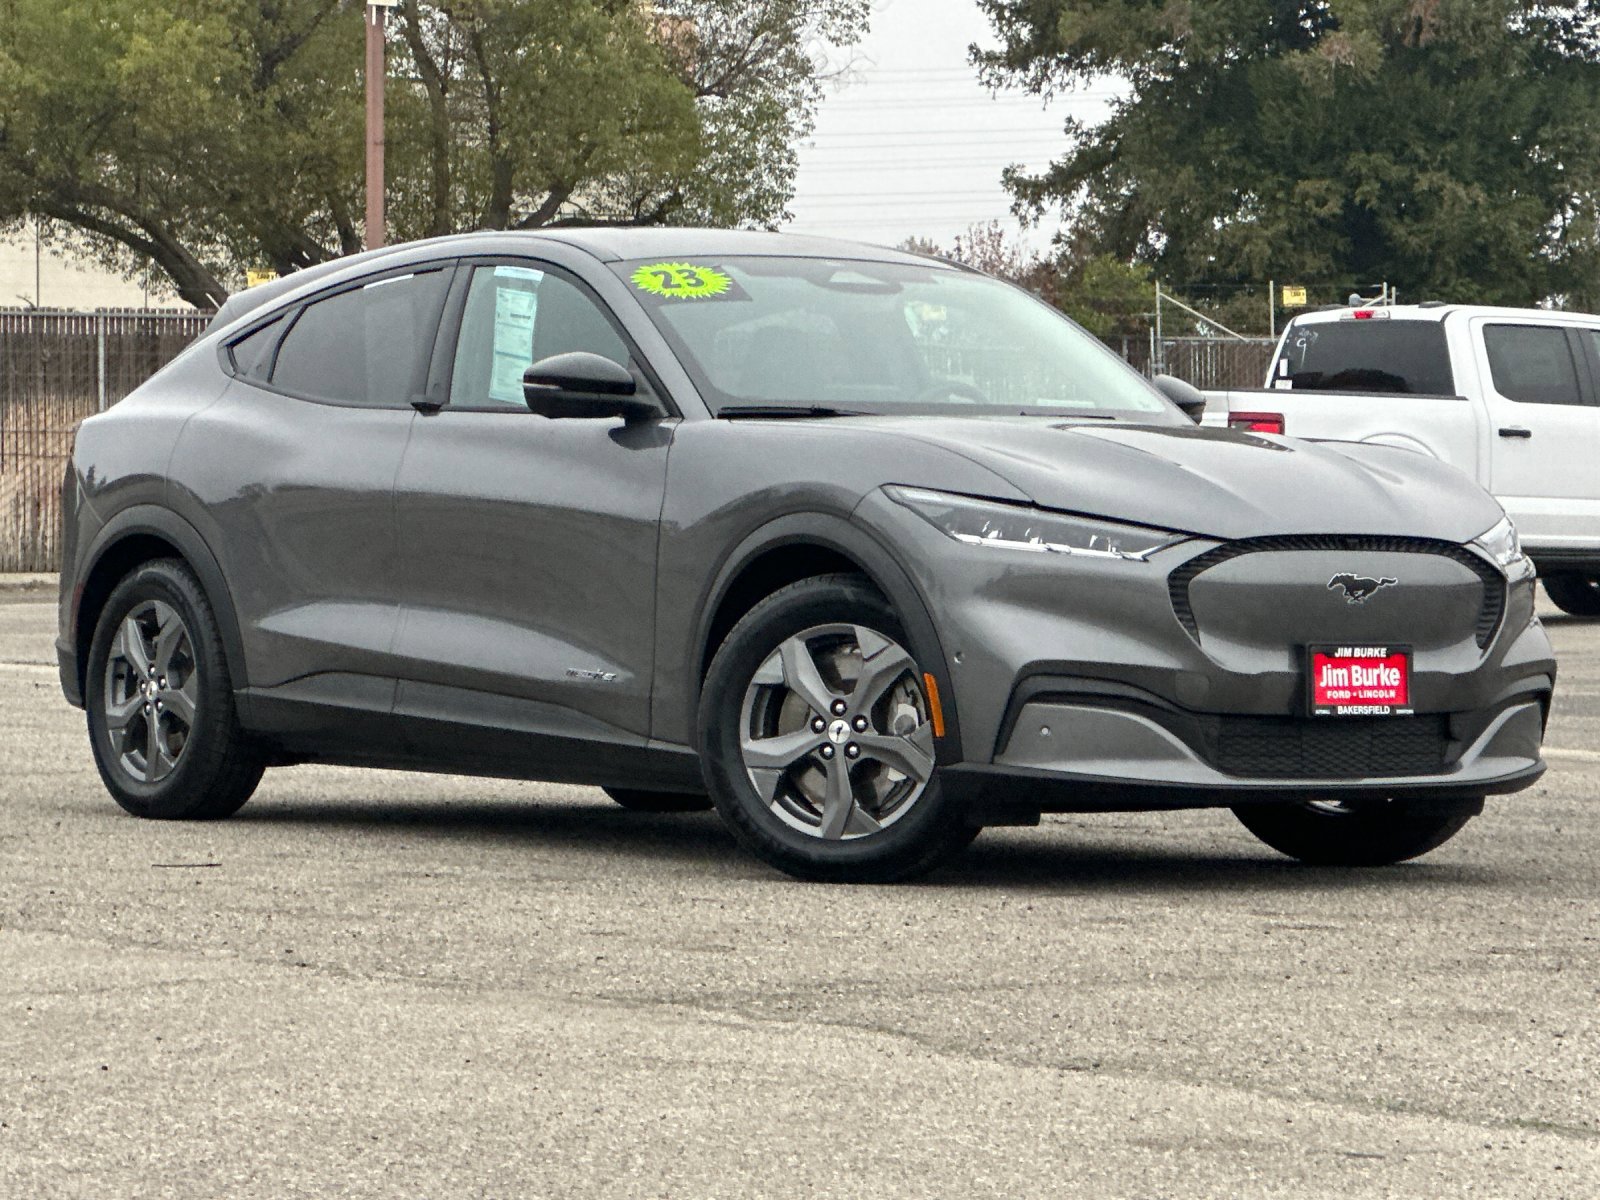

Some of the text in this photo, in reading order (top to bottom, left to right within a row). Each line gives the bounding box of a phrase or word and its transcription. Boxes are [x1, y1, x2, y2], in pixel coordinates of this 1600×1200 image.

[650, 268, 705, 289] 23
[1334, 647, 1388, 658] JIM BURKE
[1319, 662, 1401, 687] Jim Burke
[1326, 689, 1396, 699] FORD LINCOLN
[1337, 705, 1391, 715] BAKERSFIELD
